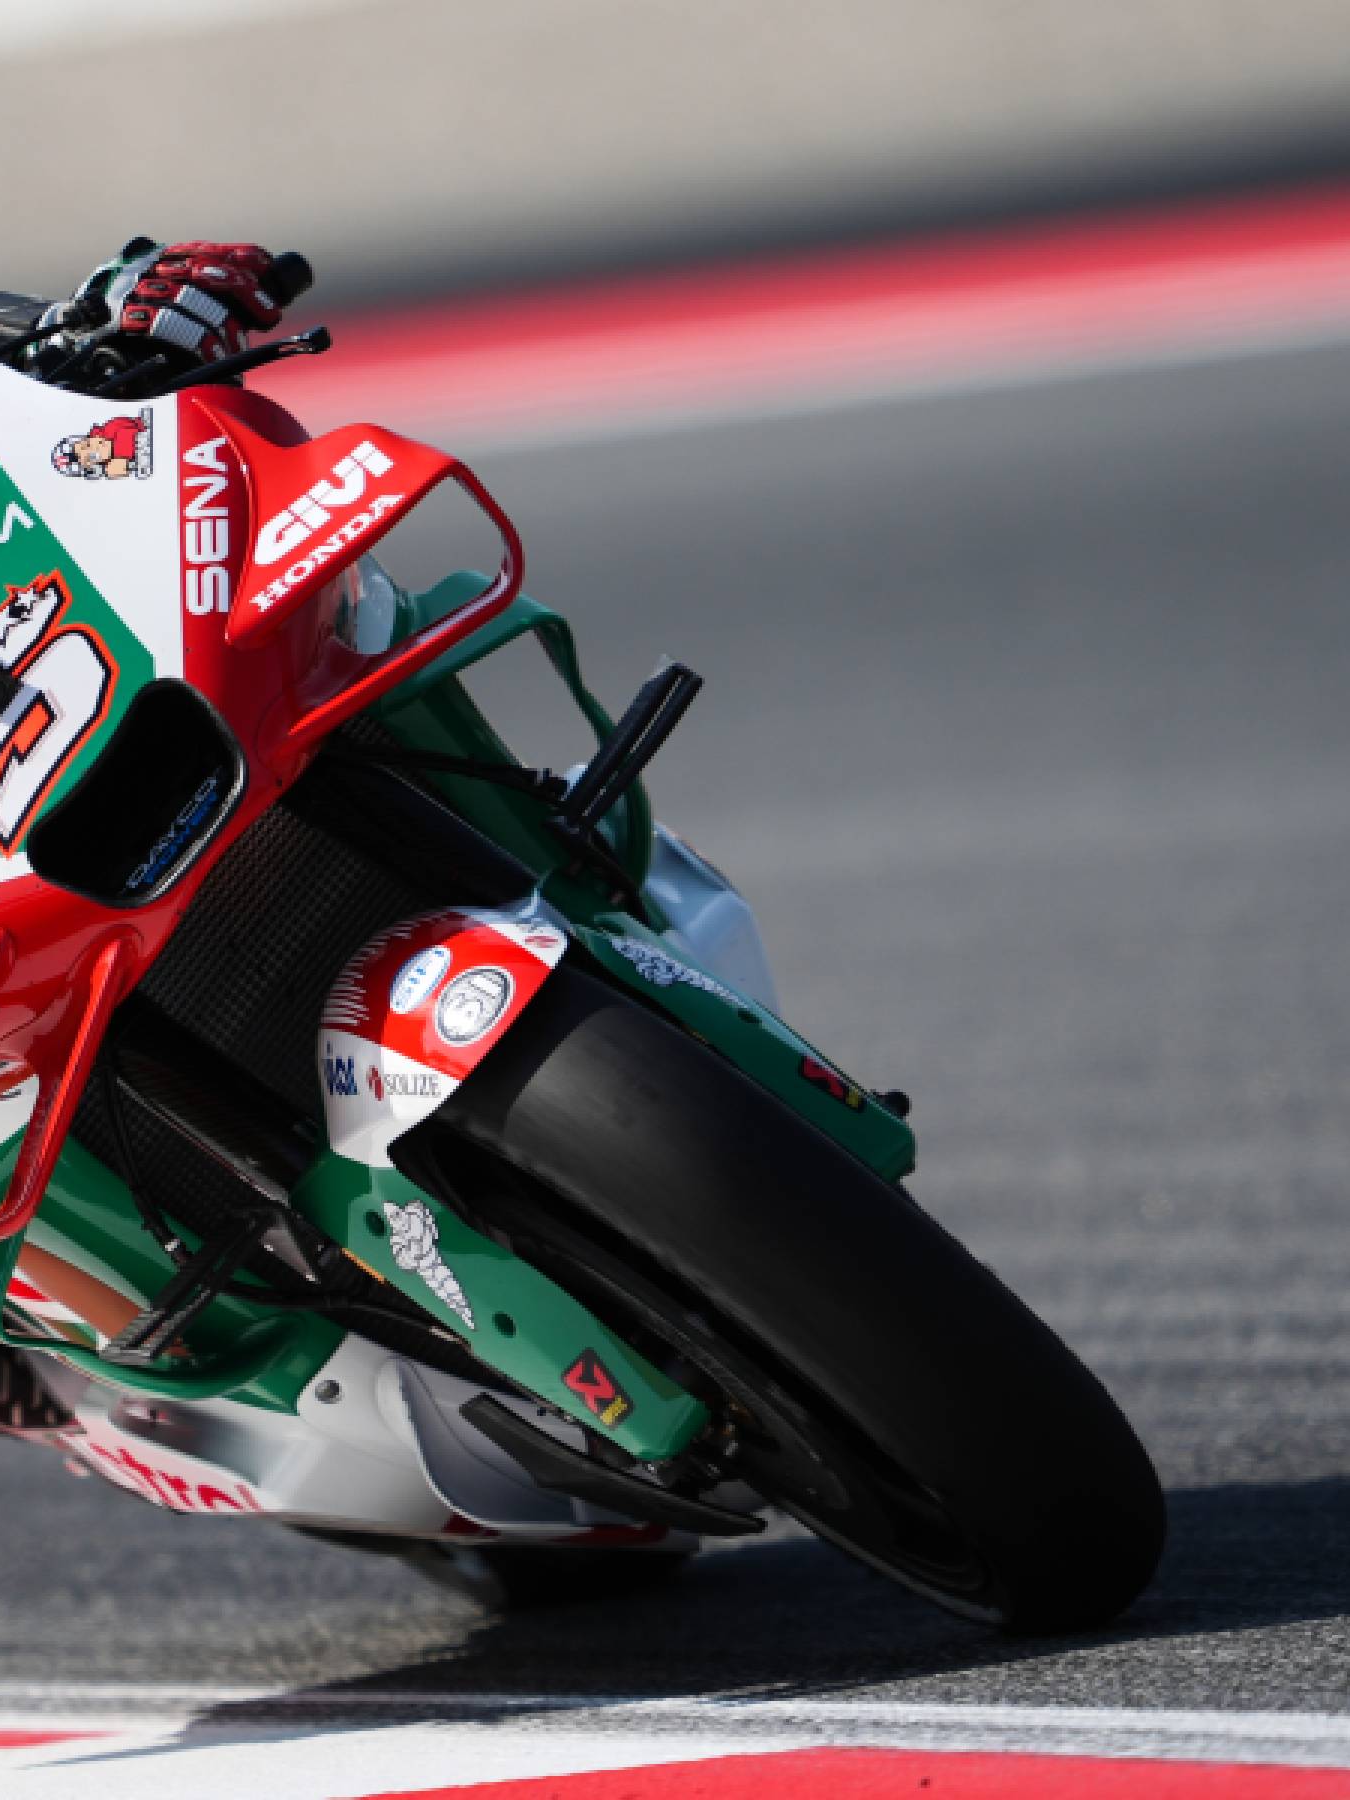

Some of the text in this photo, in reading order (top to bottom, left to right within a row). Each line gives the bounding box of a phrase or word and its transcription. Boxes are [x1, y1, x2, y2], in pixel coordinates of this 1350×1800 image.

[184, 436, 229, 616] SENA
[251, 439, 395, 566] GIVI
[251, 493, 404, 613] HONDA
[383, 1073, 442, 1098] SOLIZE
